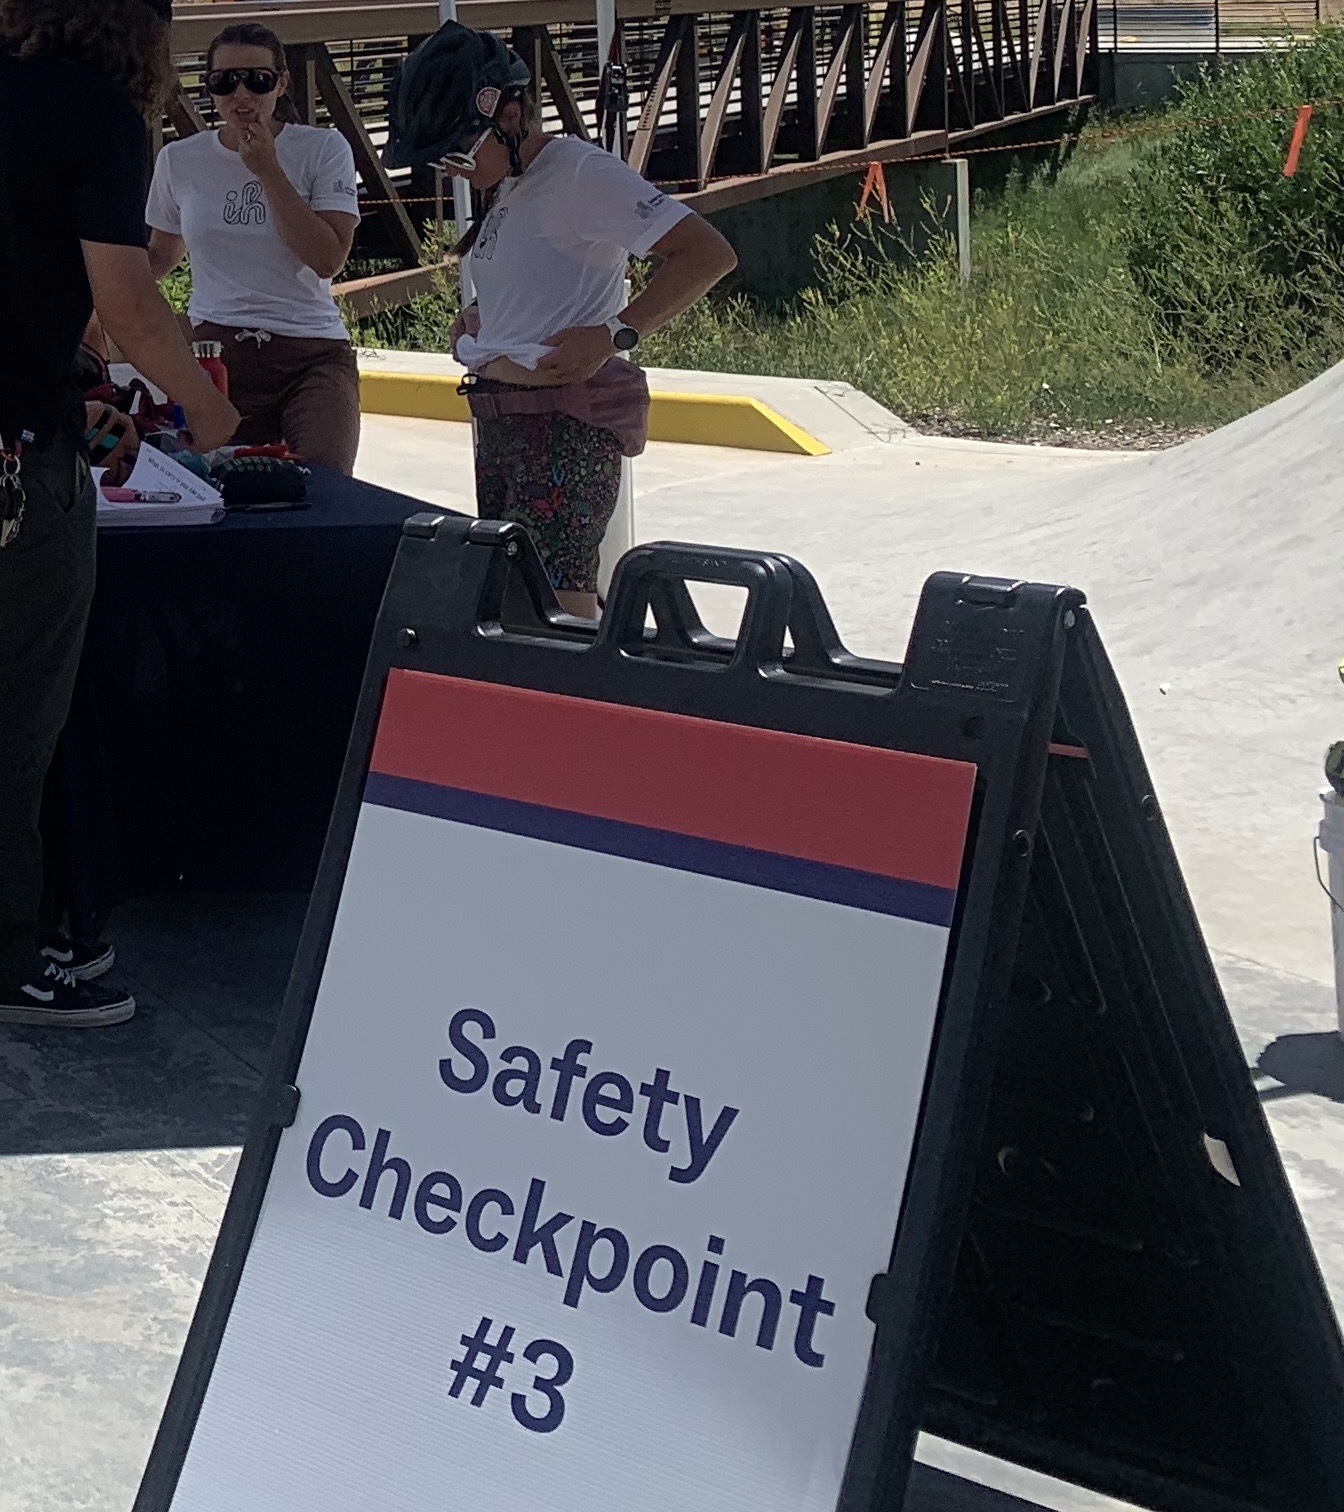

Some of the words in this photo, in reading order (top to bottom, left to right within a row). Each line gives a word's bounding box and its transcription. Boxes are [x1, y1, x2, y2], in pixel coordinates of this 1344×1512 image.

[438, 1007, 741, 1185] Safety
[306, 1113, 836, 1369] Checkpoint
[446, 1316, 575, 1434] #3
